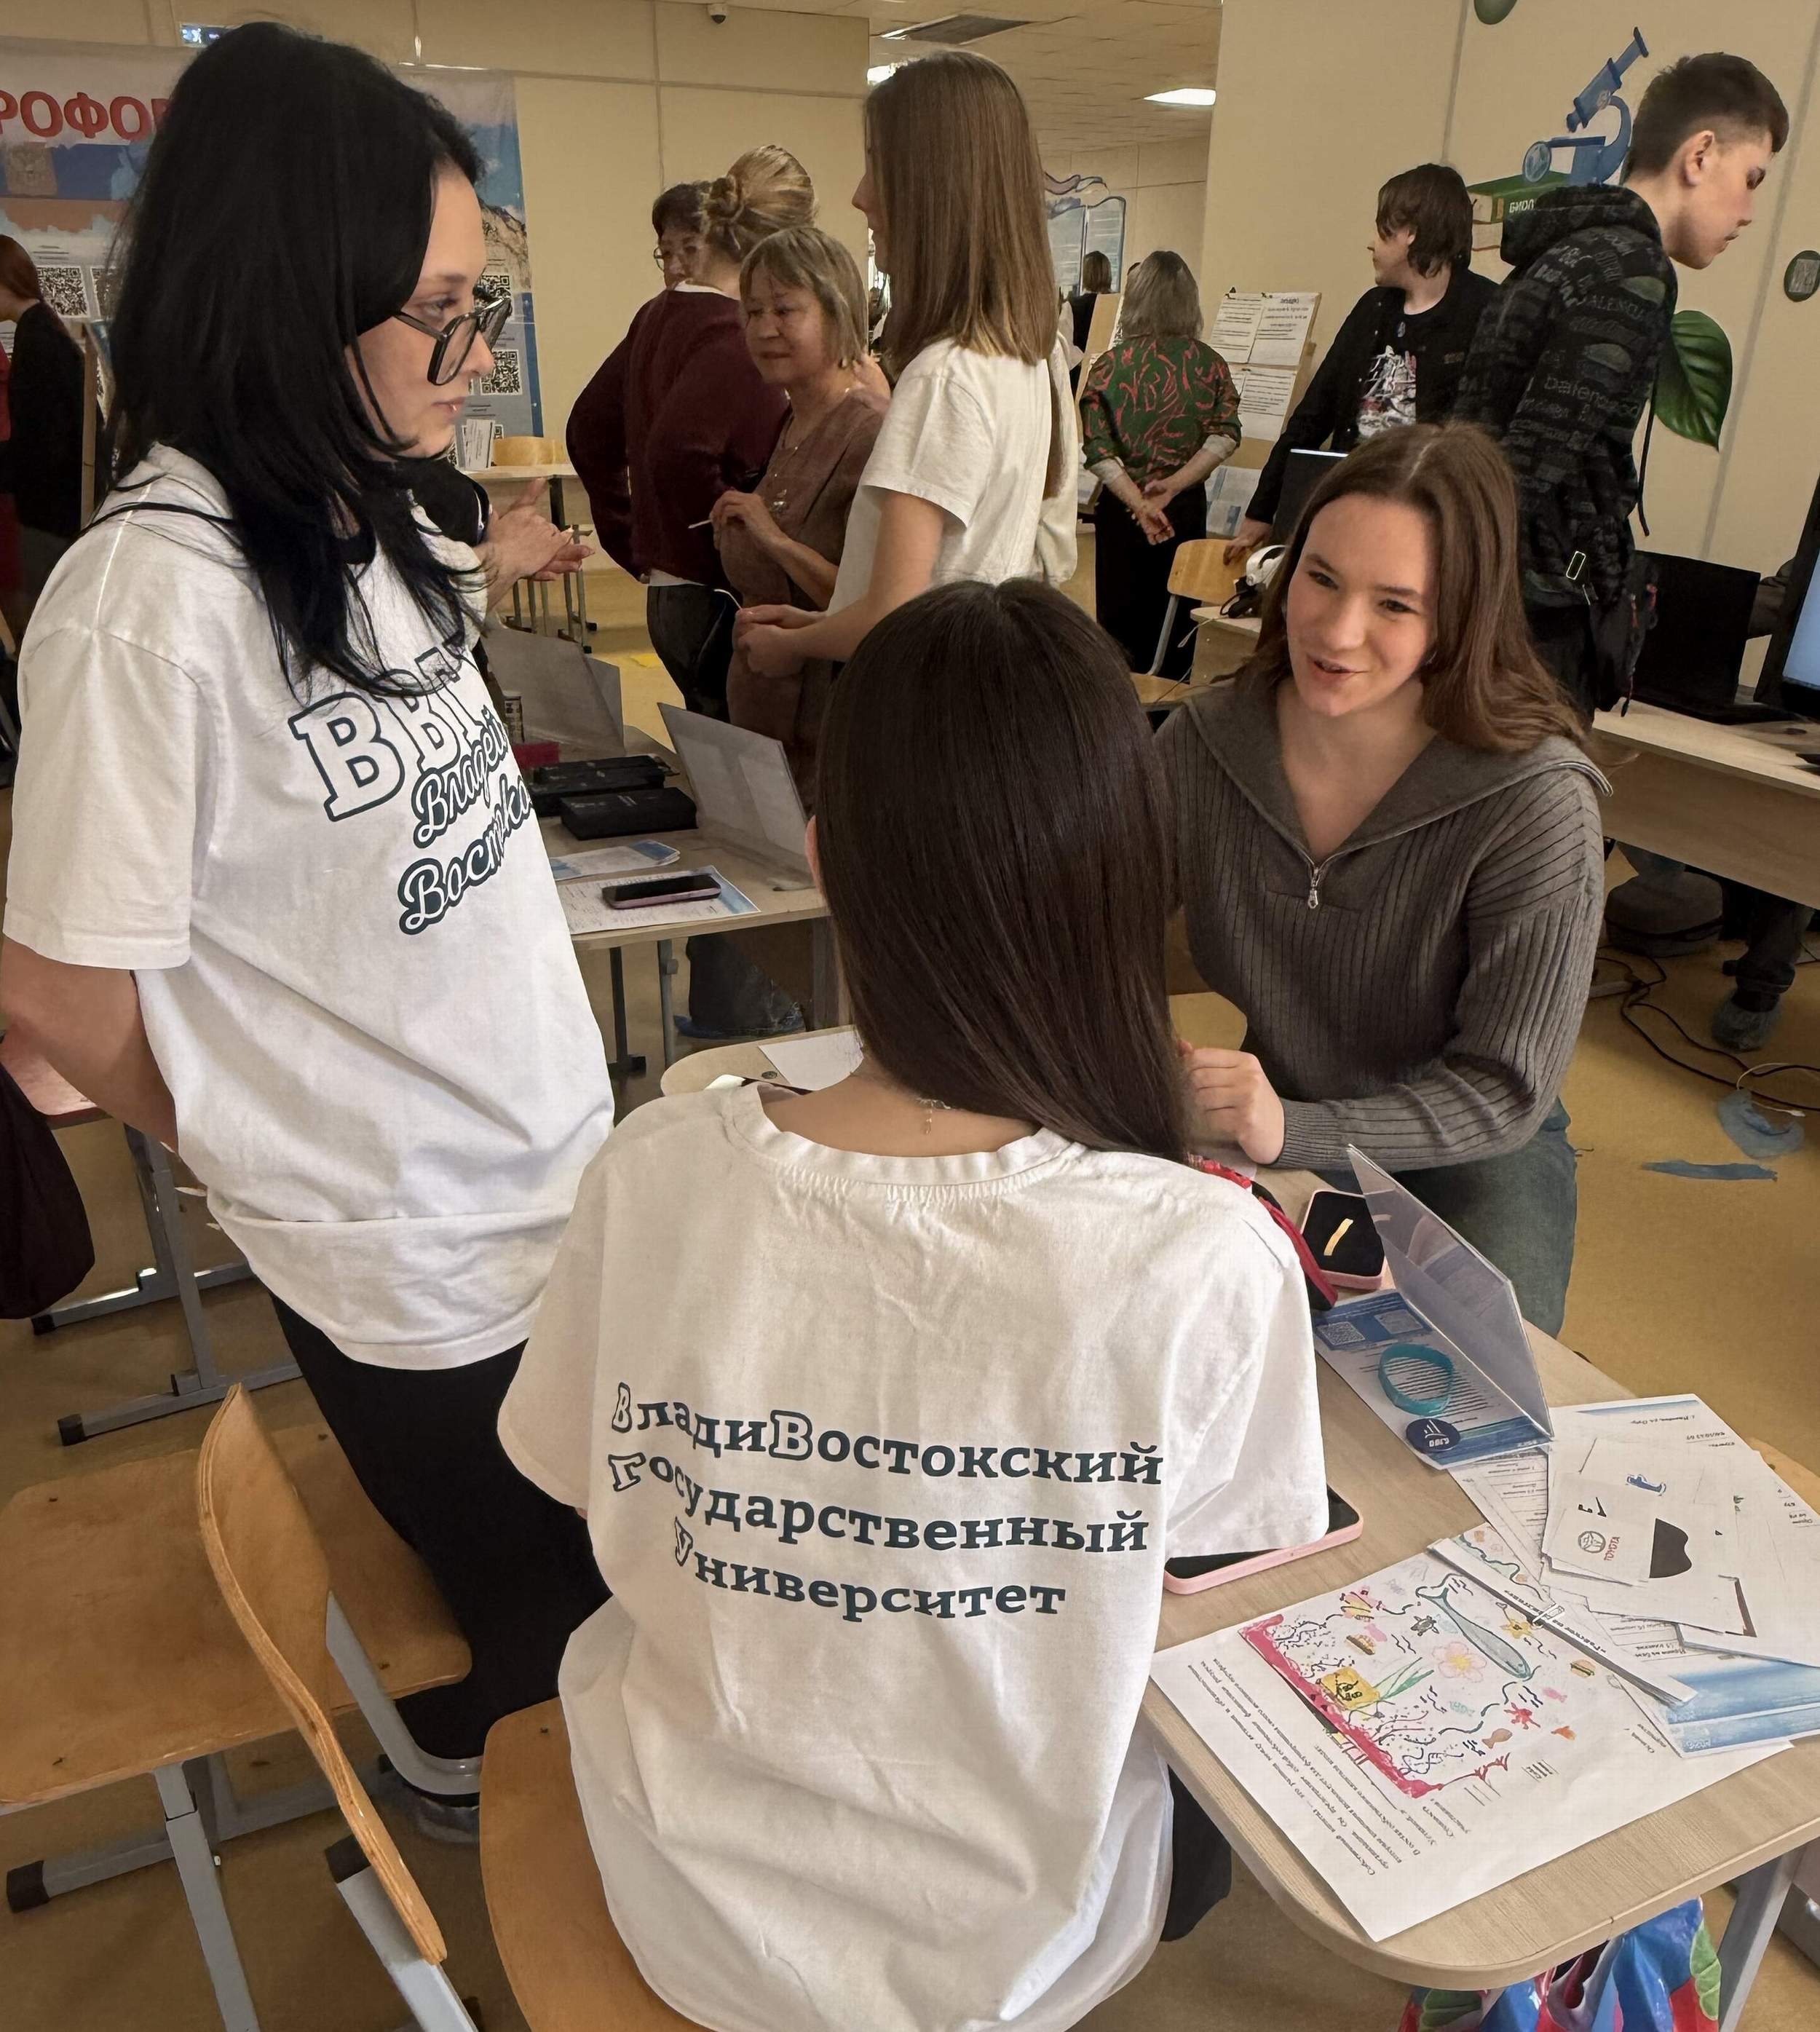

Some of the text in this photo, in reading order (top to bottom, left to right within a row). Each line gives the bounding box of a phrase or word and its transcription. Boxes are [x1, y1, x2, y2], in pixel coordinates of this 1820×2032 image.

[0, 89, 169, 142] РОФО
[611, 1381, 1163, 1485] ВладиВостокский
[606, 1452, 1149, 1552] Государственный
[1603, 1535, 1621, 1562] TOYOTA
[673, 1516, 1067, 1622] Университет
